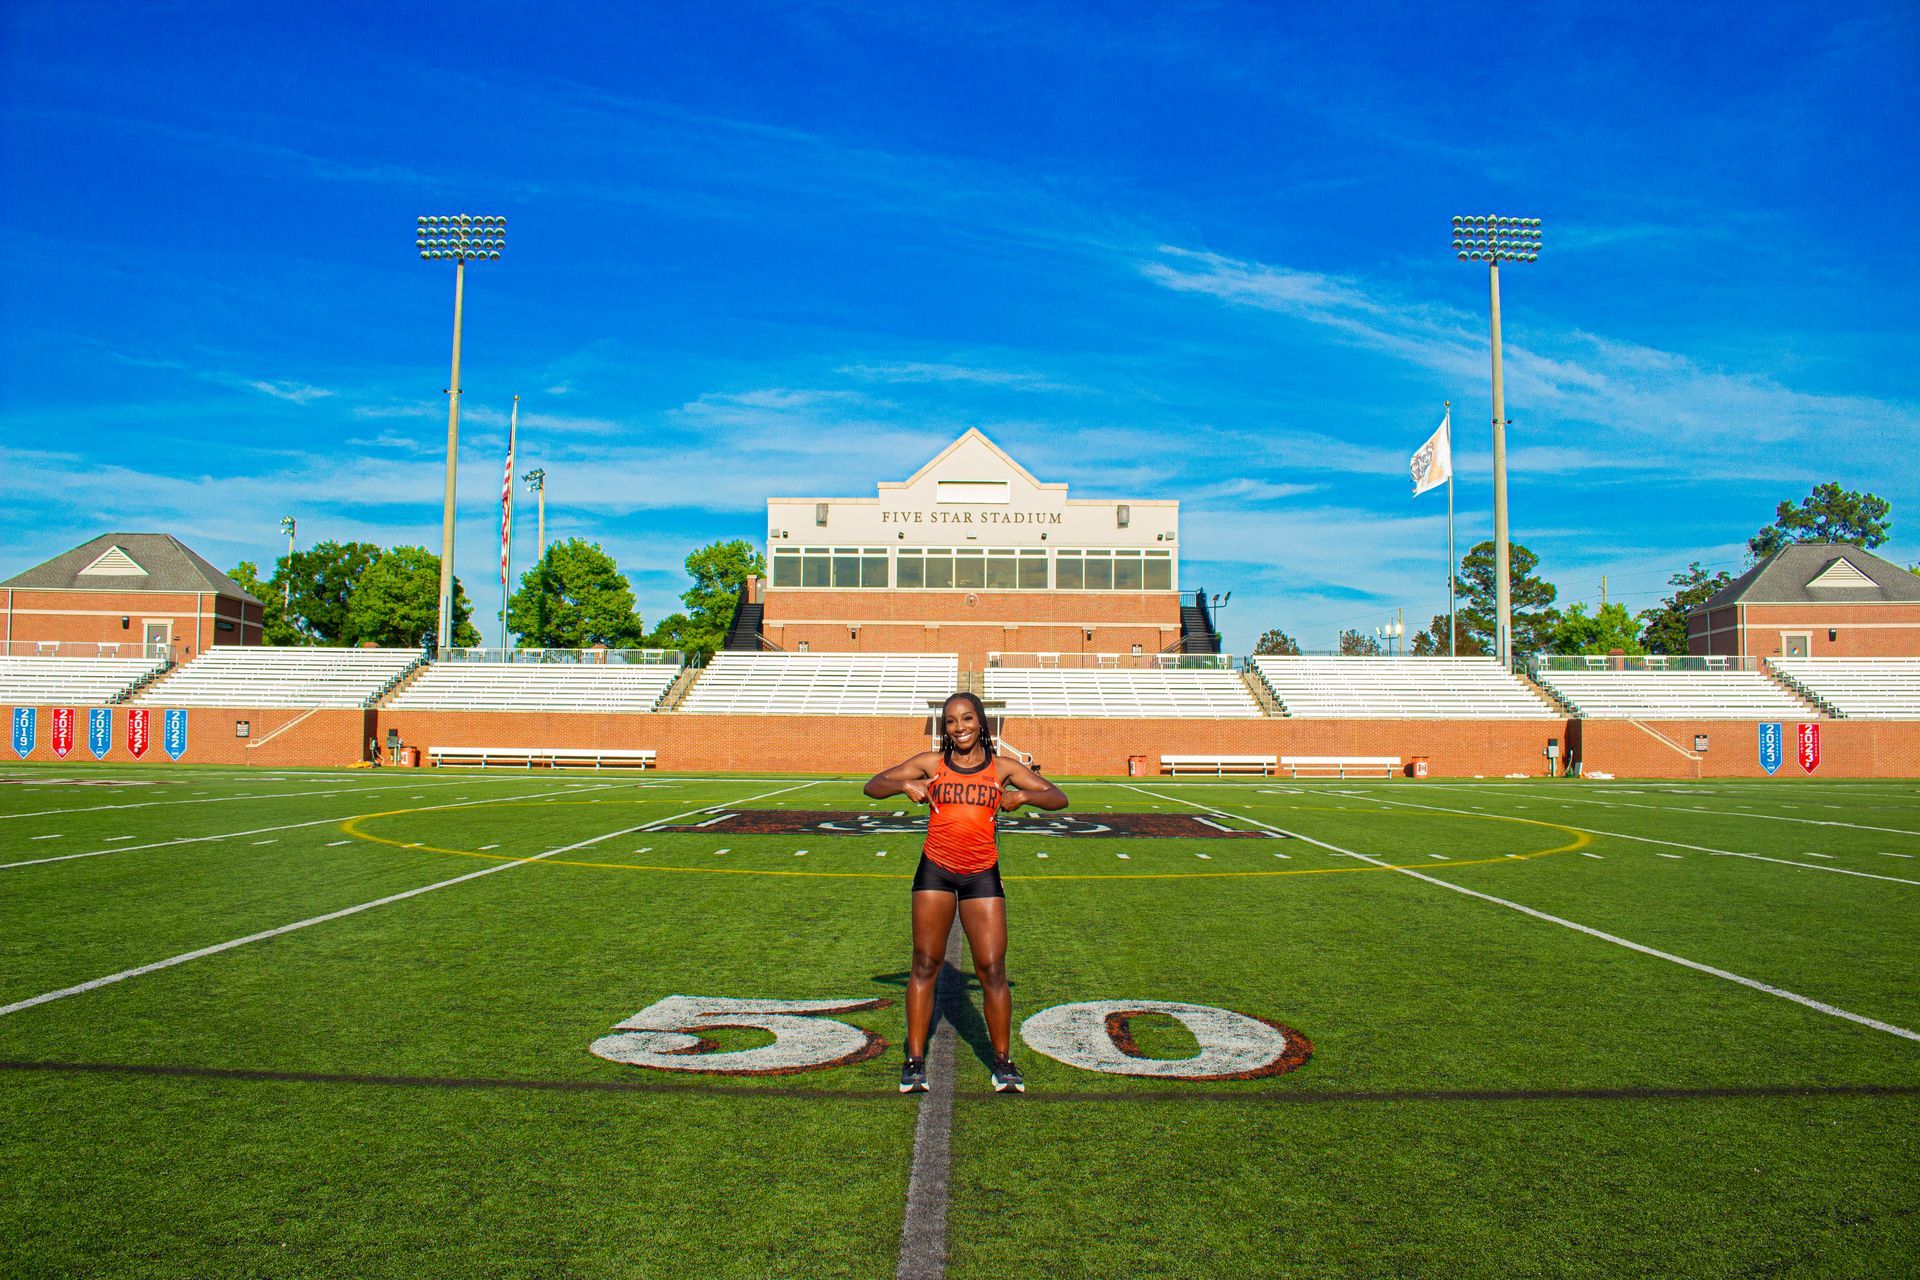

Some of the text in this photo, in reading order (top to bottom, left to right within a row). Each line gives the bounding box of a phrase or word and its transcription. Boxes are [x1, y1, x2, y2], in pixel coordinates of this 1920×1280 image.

[882, 511, 1062, 524] FIVE STAR STADIUM
[19, 708, 29, 747] 2019
[58, 708, 68, 747] 2021
[96, 709, 105, 747] 2021
[134, 709, 143, 748] 2022
[171, 711, 180, 748] 2022
[1766, 724, 1775, 762] 2023
[1804, 724, 1814, 763] 2023
[932, 782, 997, 809] MERCER
